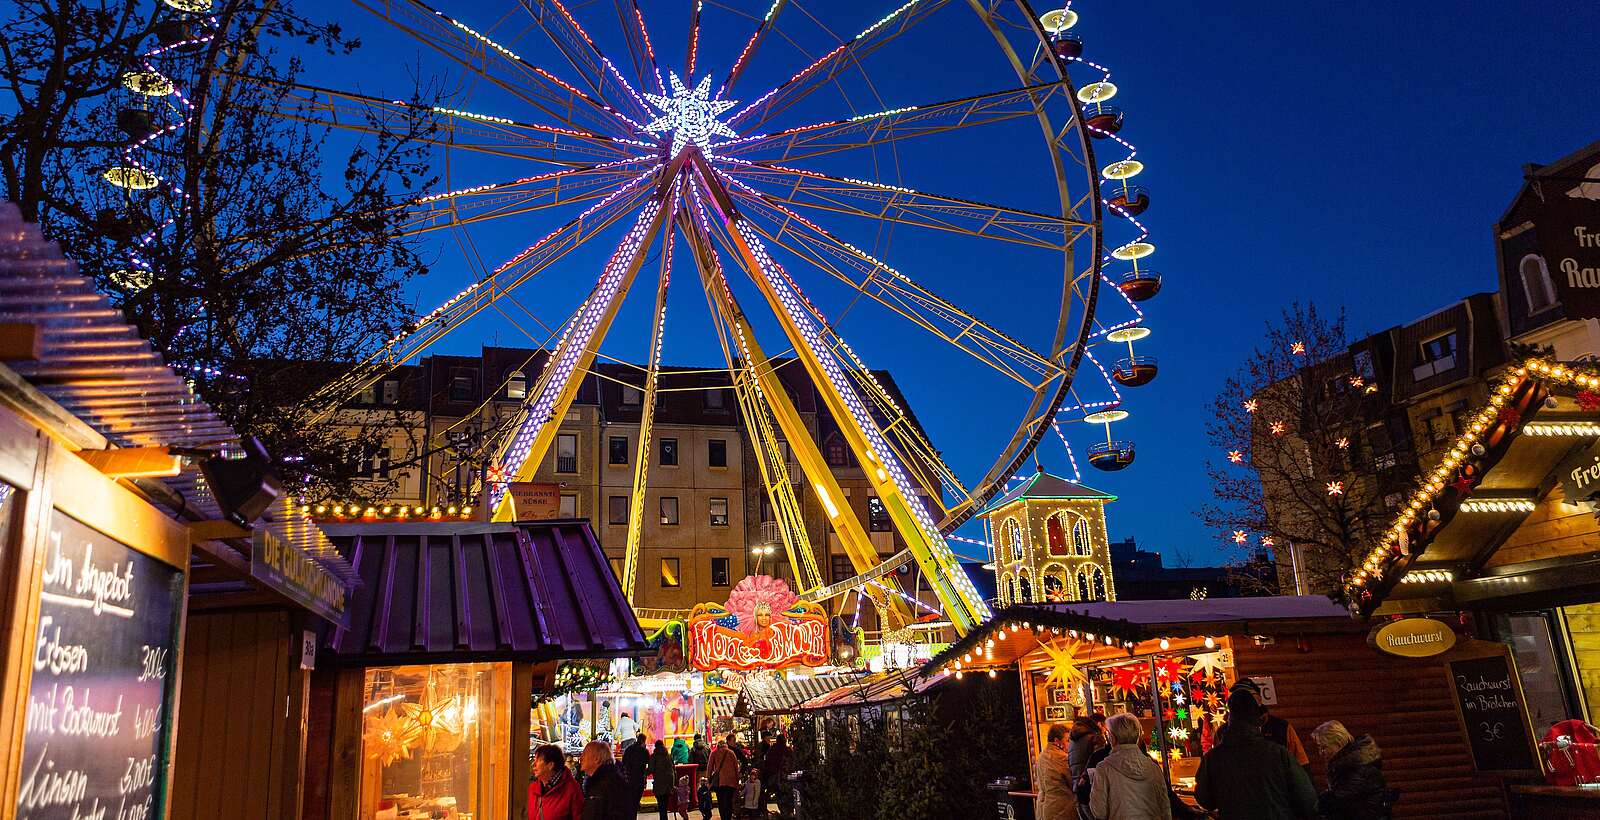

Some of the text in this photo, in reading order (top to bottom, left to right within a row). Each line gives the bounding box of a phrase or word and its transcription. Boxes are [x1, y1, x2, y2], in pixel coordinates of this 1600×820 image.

[264, 529, 280, 571] DIE
[76, 543, 134, 616] Angebot
[34, 615, 88, 675] Erbsen
[1386, 631, 1443, 646] Rauchwurst
[27, 683, 58, 735] mit
[60, 686, 123, 737] Bockwurst
